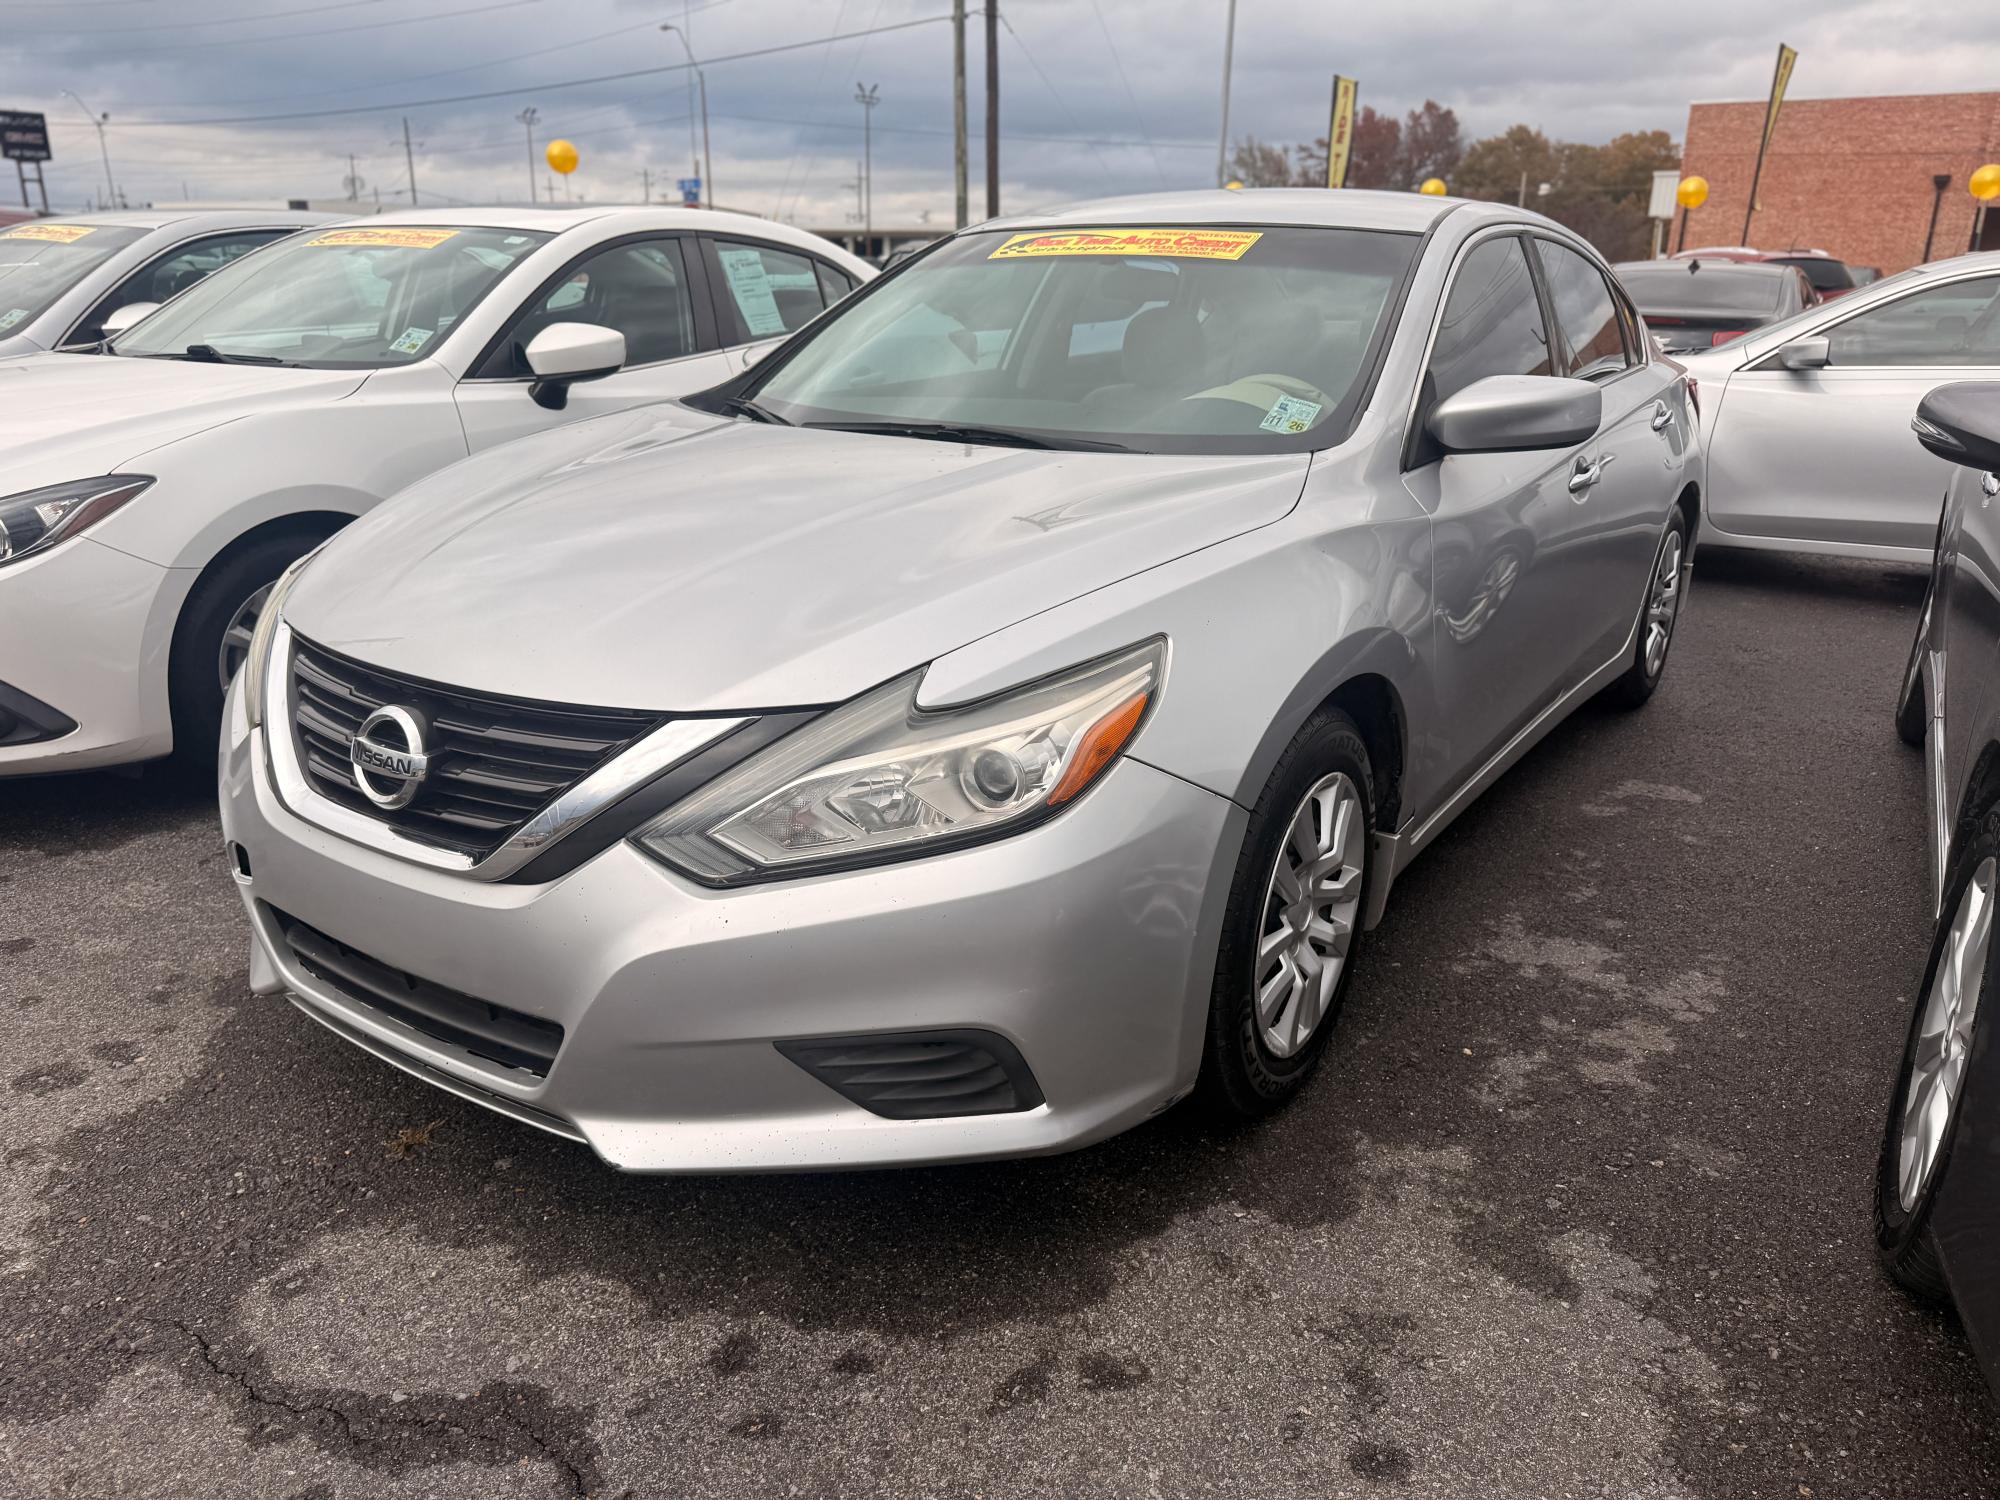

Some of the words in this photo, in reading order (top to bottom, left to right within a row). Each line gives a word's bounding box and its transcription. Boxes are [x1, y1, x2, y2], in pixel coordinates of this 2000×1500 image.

[1269, 415, 1283, 426] 11
[1288, 421, 1305, 431] 26
[353, 740, 412, 775] NISSAN
